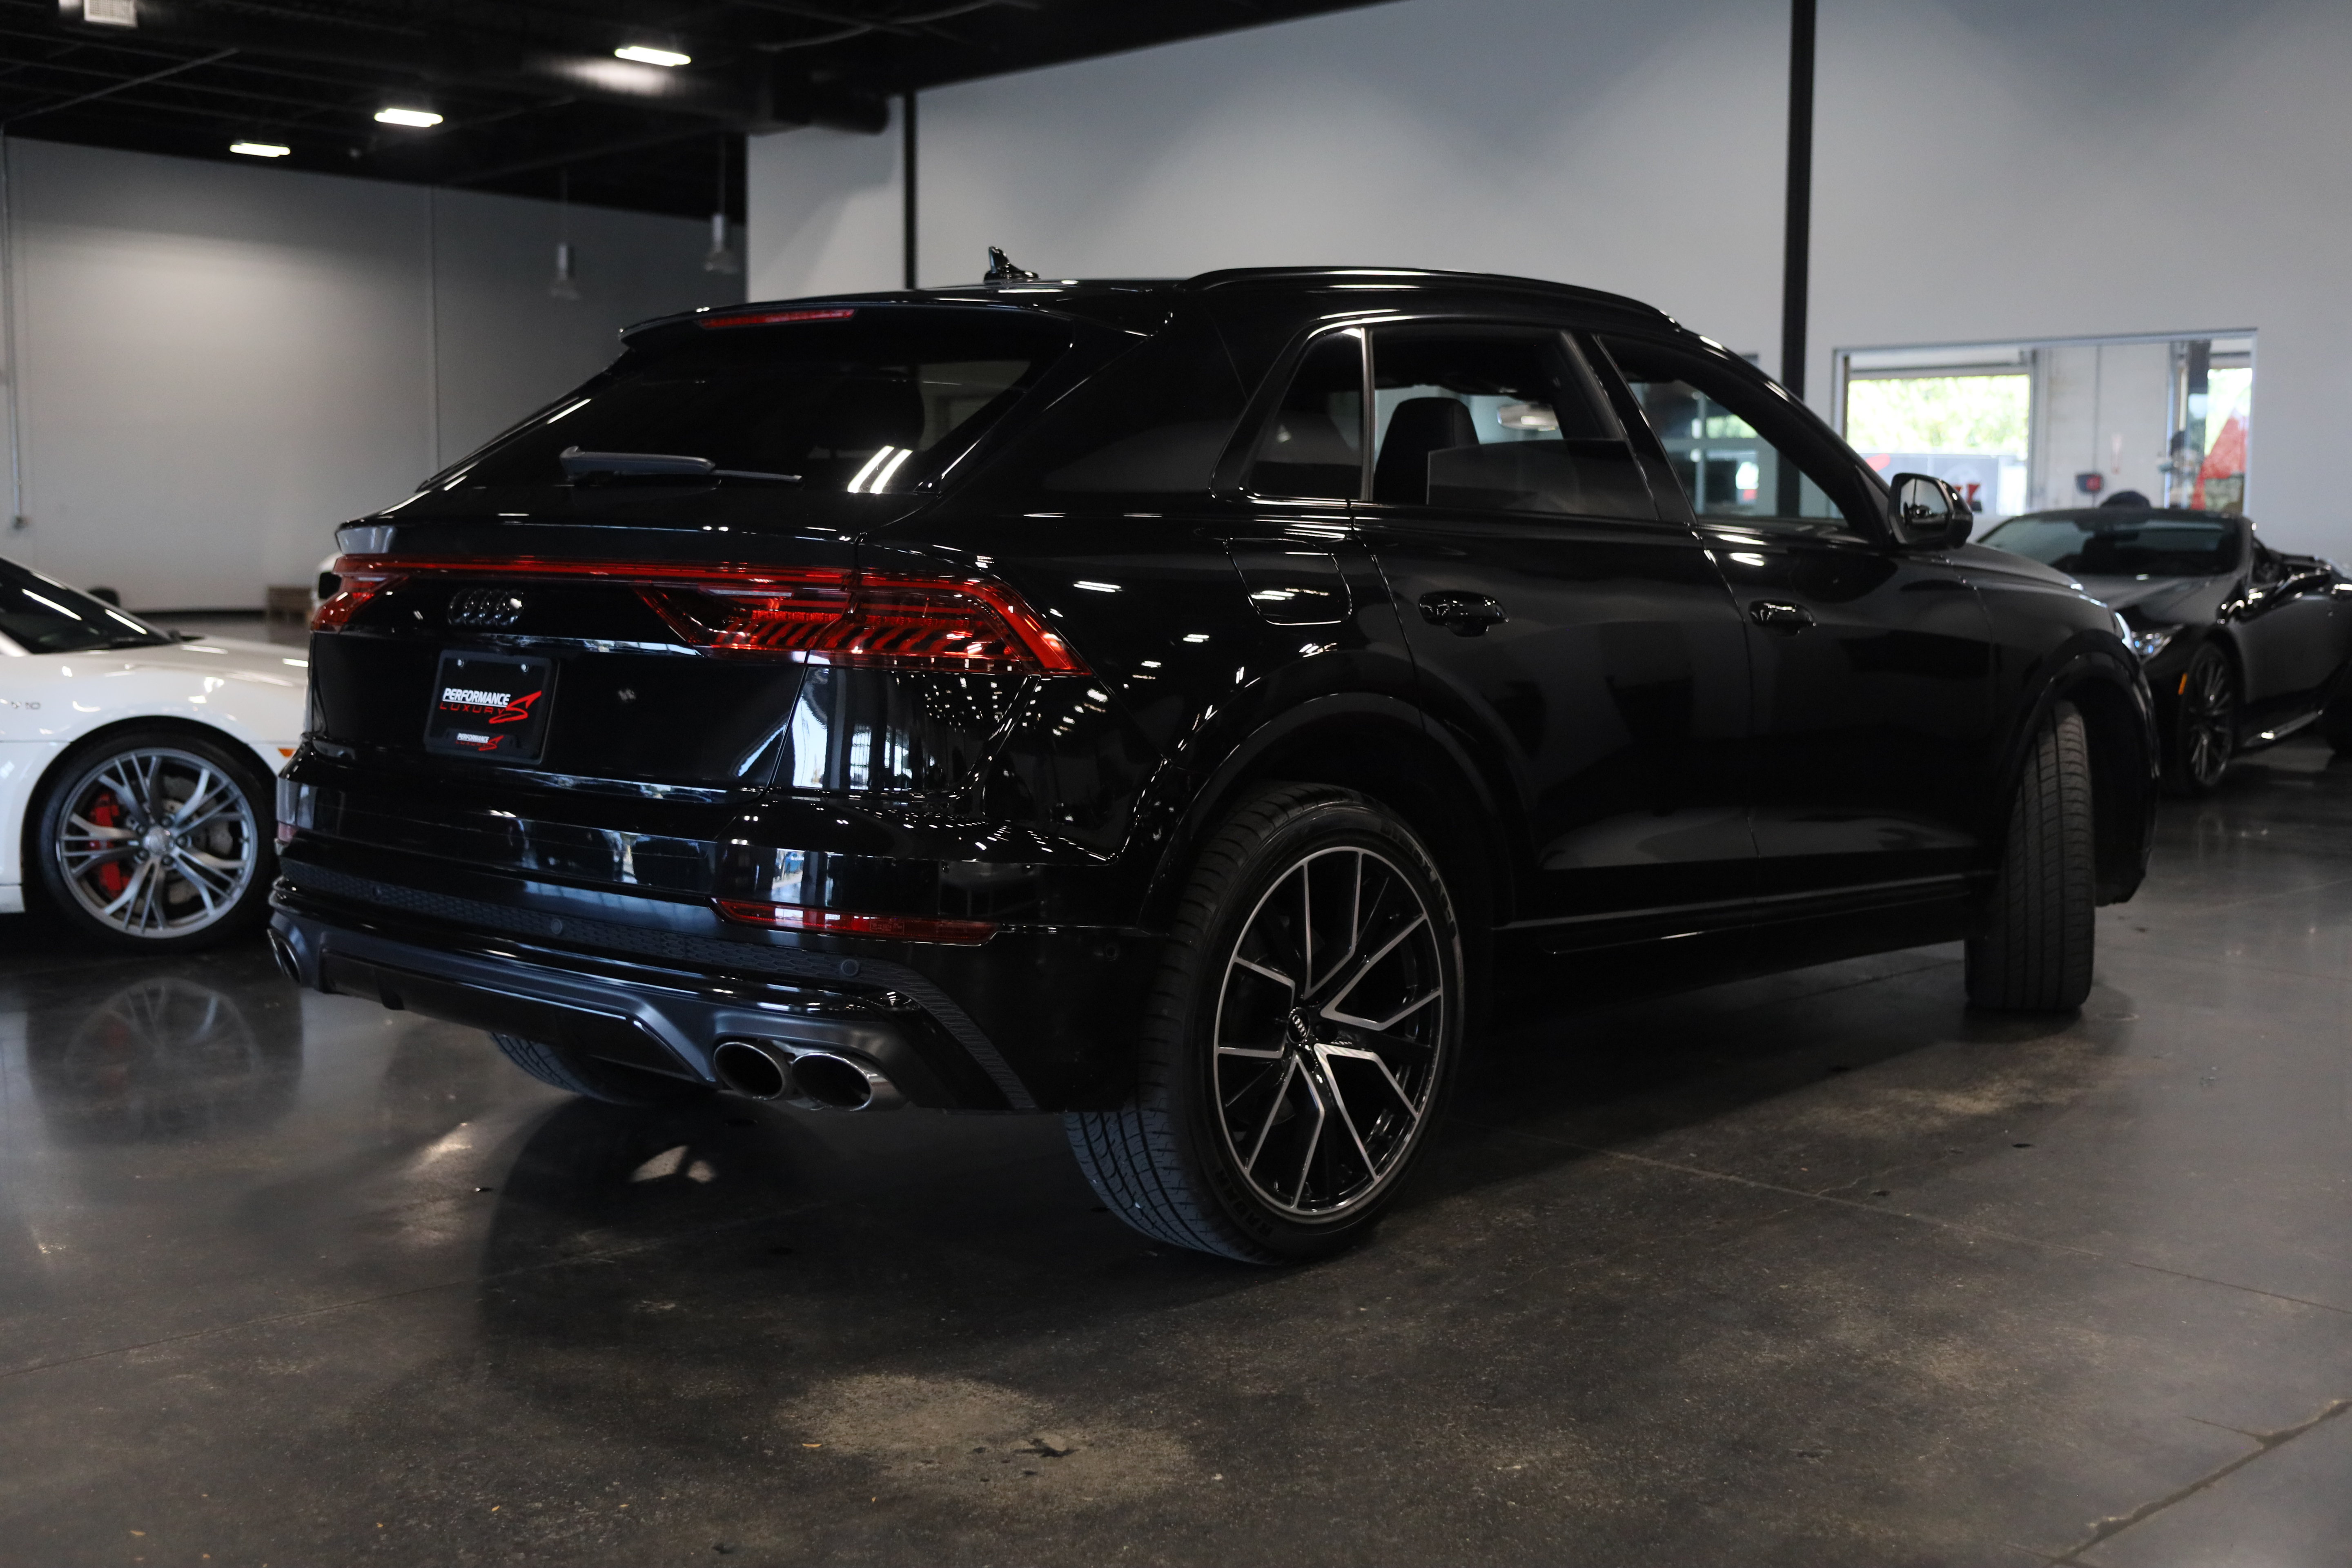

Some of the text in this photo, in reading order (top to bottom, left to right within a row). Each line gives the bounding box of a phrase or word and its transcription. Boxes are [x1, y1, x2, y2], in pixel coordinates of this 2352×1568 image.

[443, 687, 511, 706] PERFORMANCE
[440, 702, 505, 714] LUXURY
[457, 733, 490, 744] PERFORMANCE
